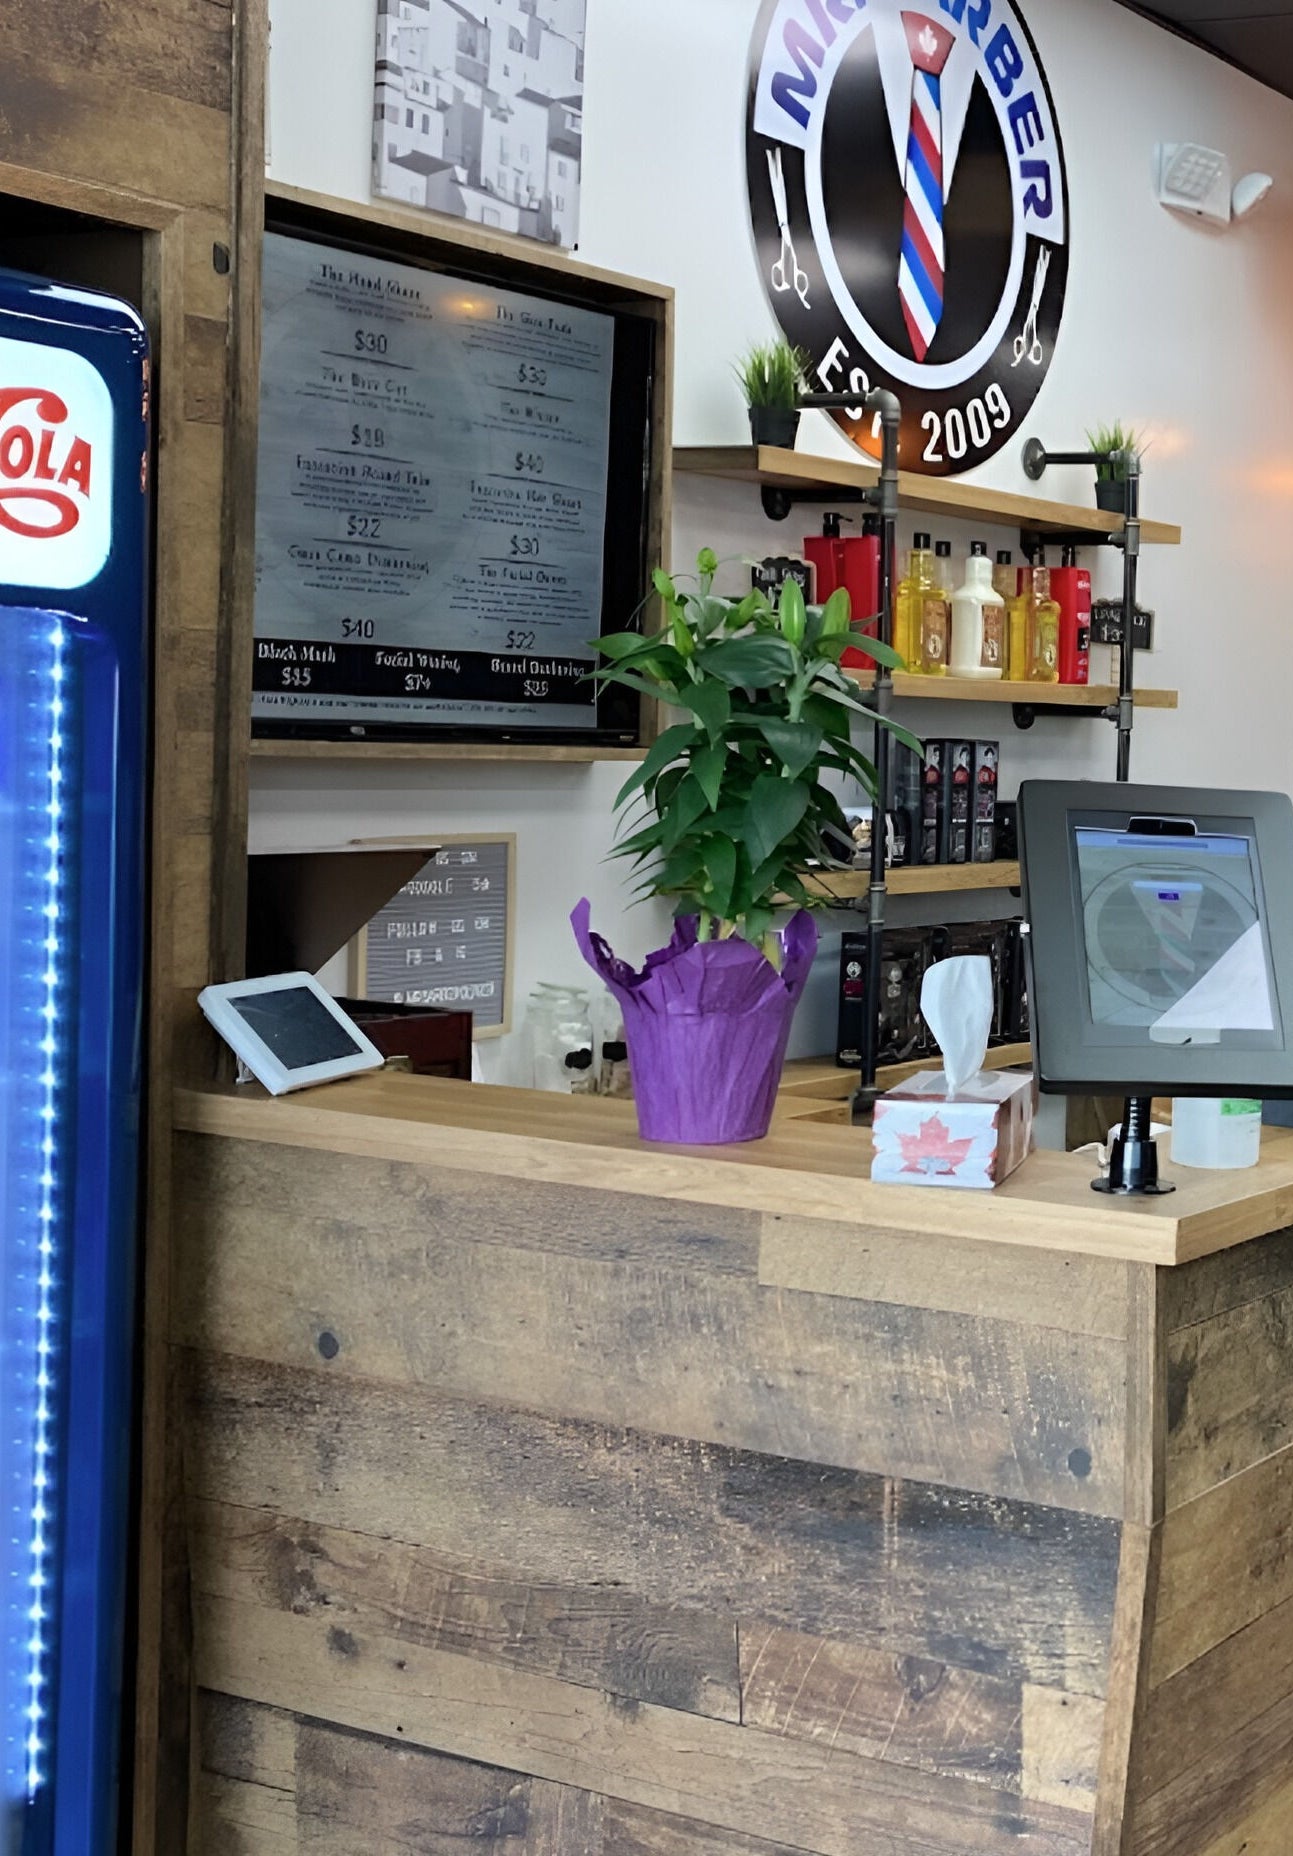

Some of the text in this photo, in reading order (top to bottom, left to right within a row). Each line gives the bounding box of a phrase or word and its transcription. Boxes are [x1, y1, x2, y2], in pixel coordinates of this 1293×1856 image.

[354, 329, 389, 354] $30
[920, 382, 1011, 462] 2009
[347, 514, 382, 539] $22
